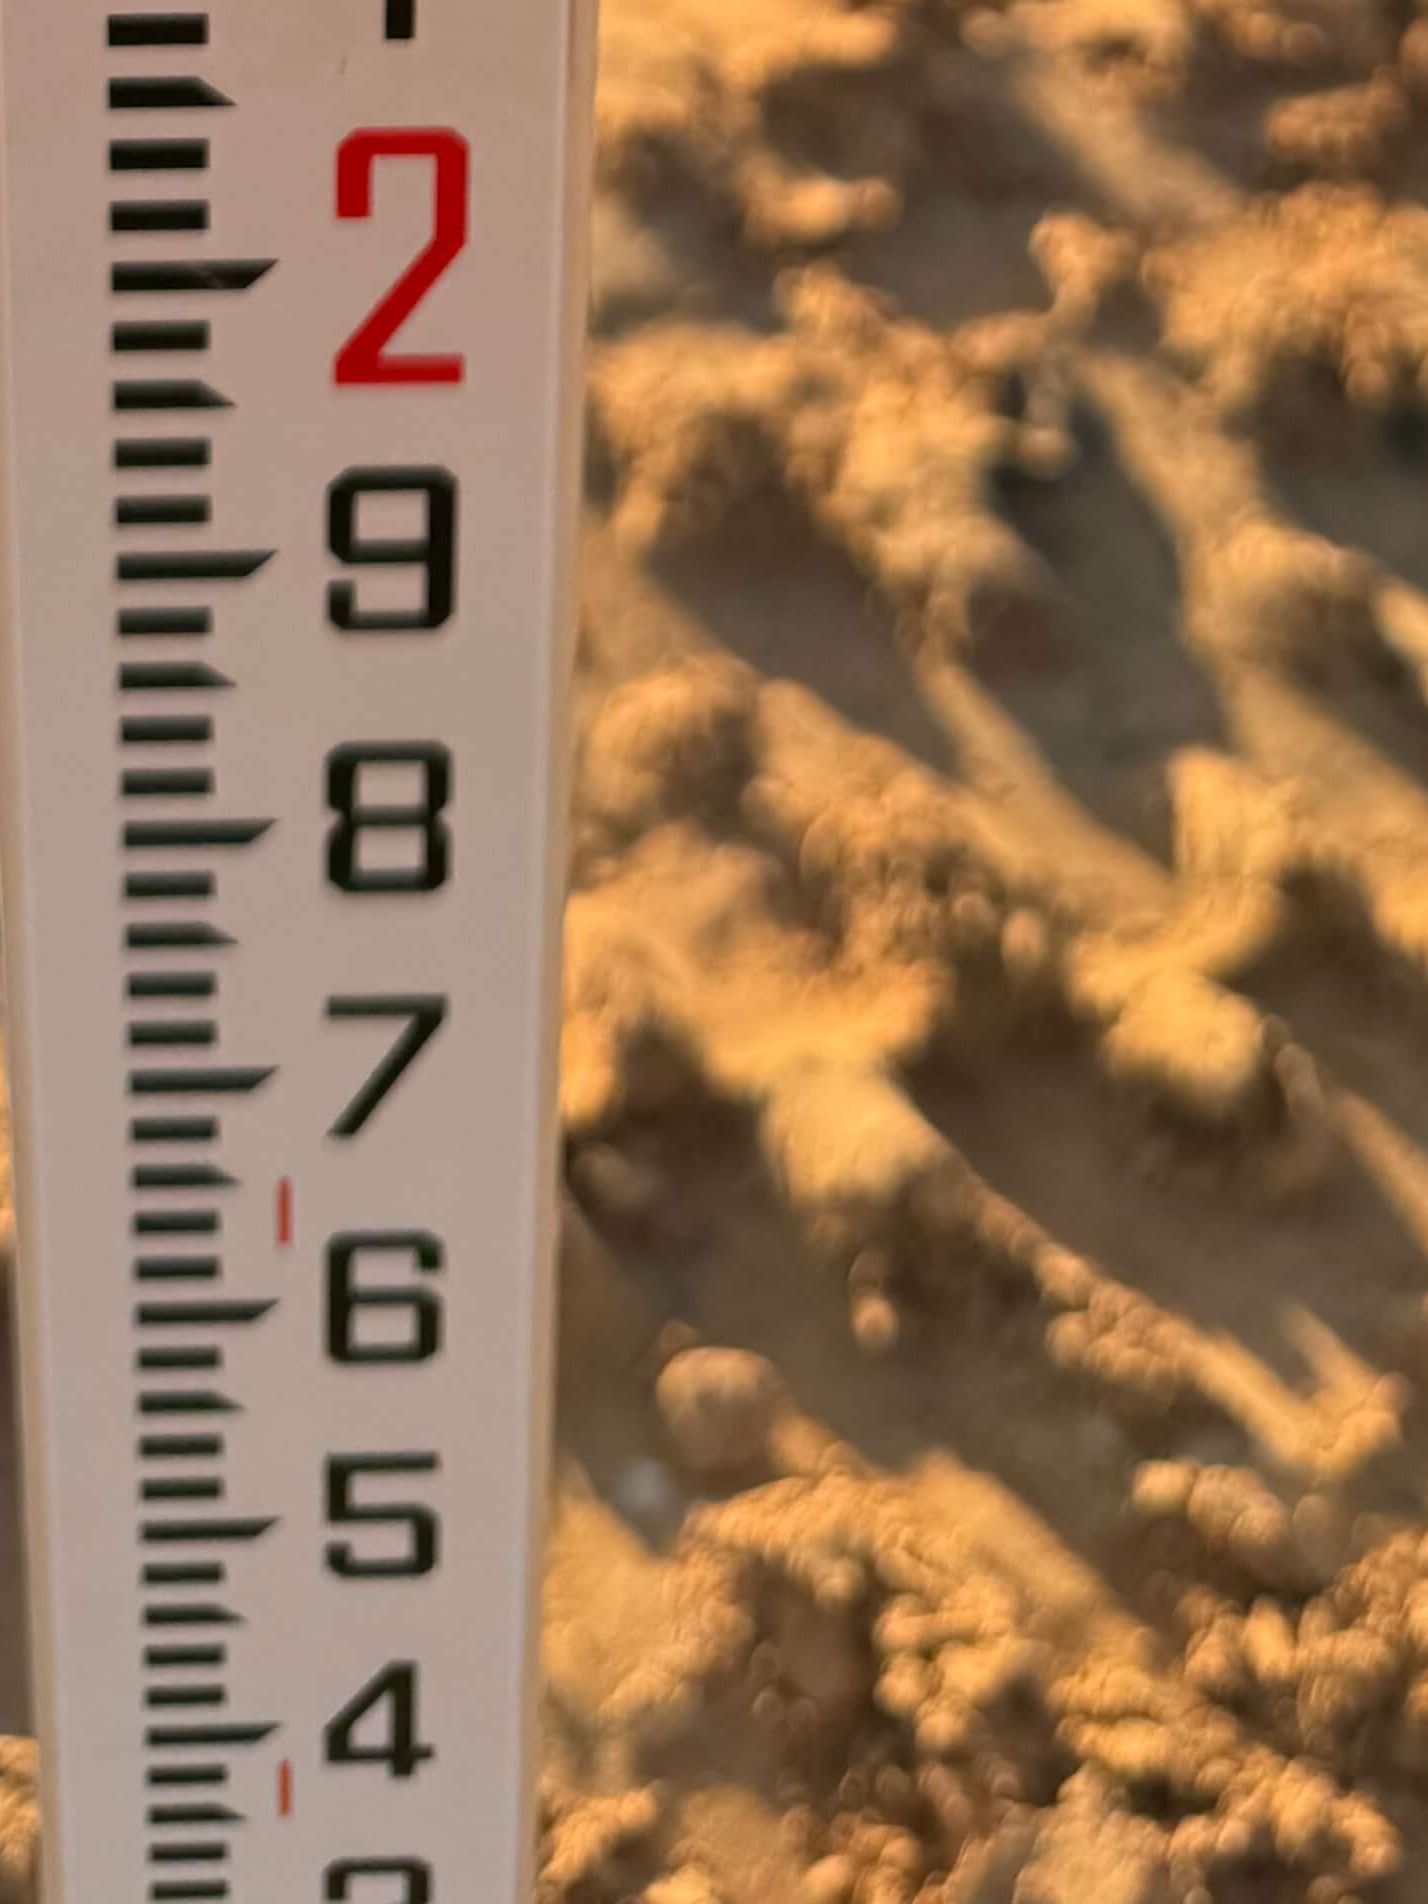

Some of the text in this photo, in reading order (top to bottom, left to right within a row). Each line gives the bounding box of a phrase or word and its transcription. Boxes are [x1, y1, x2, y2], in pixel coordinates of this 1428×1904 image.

[332, 126, 471, 388] 2
[325, 465, 459, 635] 9
[324, 741, 453, 896] 8
[325, 995, 448, 1140] 7
[324, 1231, 444, 1367] 6
[324, 1452, 439, 1579] 5
[323, 1662, 434, 1779] 4
